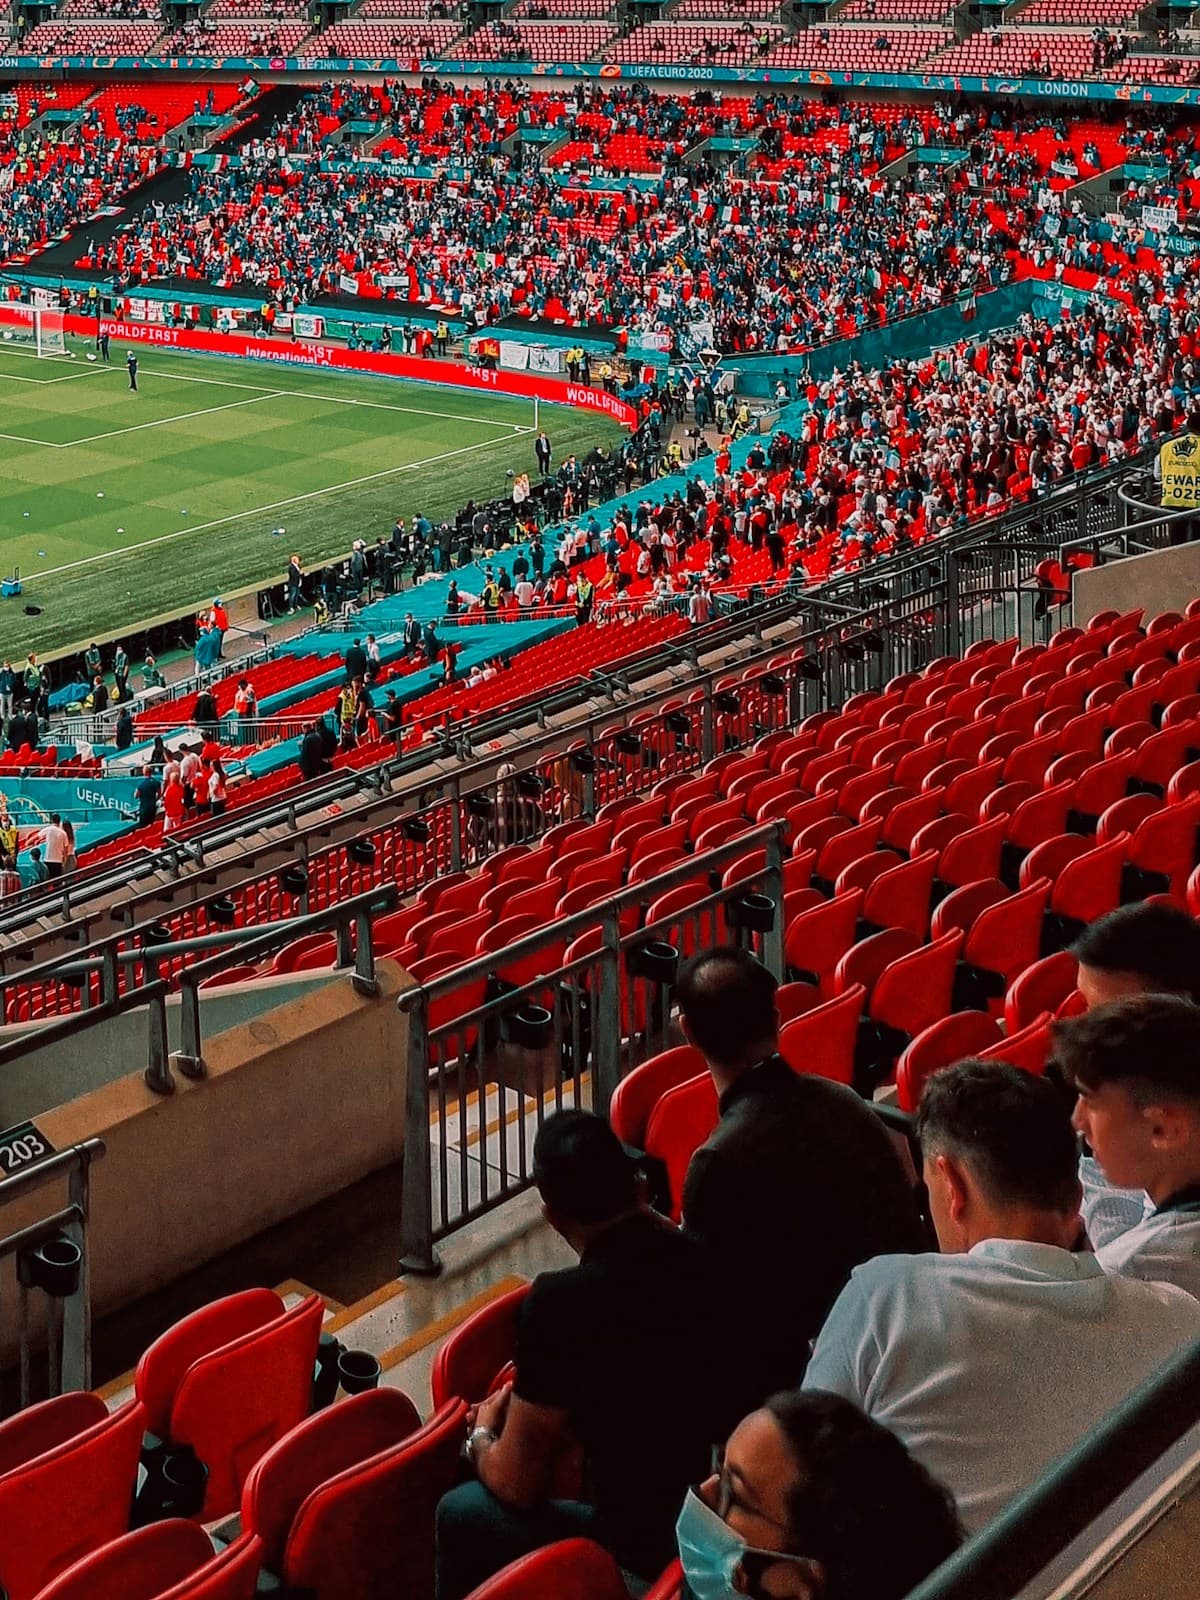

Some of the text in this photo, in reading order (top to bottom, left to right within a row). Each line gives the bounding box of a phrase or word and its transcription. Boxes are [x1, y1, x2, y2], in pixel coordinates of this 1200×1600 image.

[630, 65, 713, 79] UEFA EURO 2020
[1038, 81, 1088, 97] LONDON
[100, 321, 180, 343] WORLDFIRST
[566, 386, 628, 419] WORLDFIRST
[76, 786, 107, 808] UEFA
